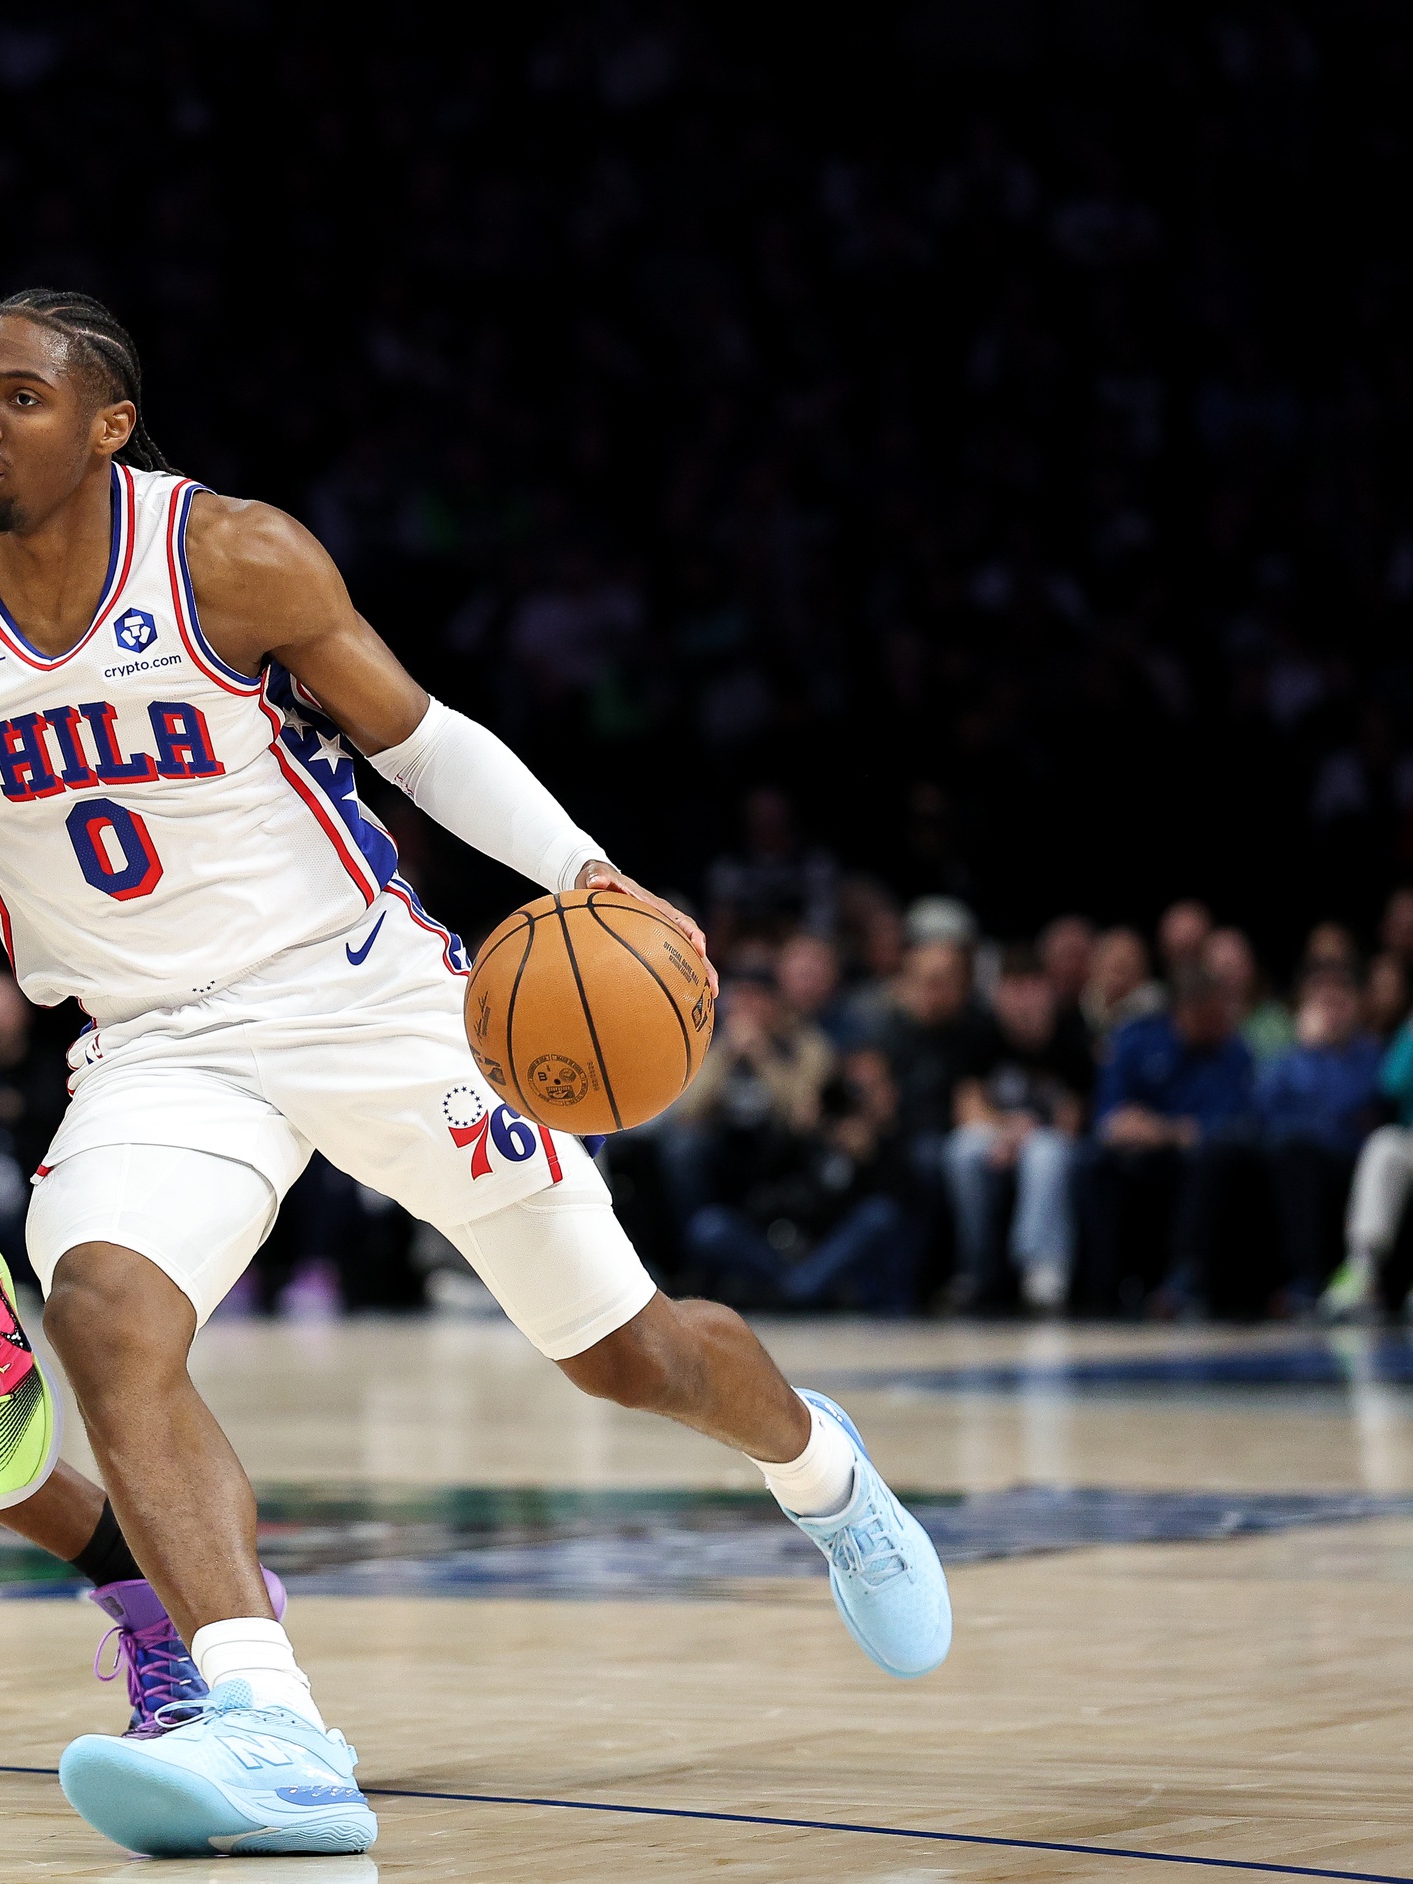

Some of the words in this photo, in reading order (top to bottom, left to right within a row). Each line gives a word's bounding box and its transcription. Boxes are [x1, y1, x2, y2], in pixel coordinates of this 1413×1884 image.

[104, 653, 182, 678] crypto.com
[65, 798, 163, 901] 0
[448, 1103, 537, 1181] 76
